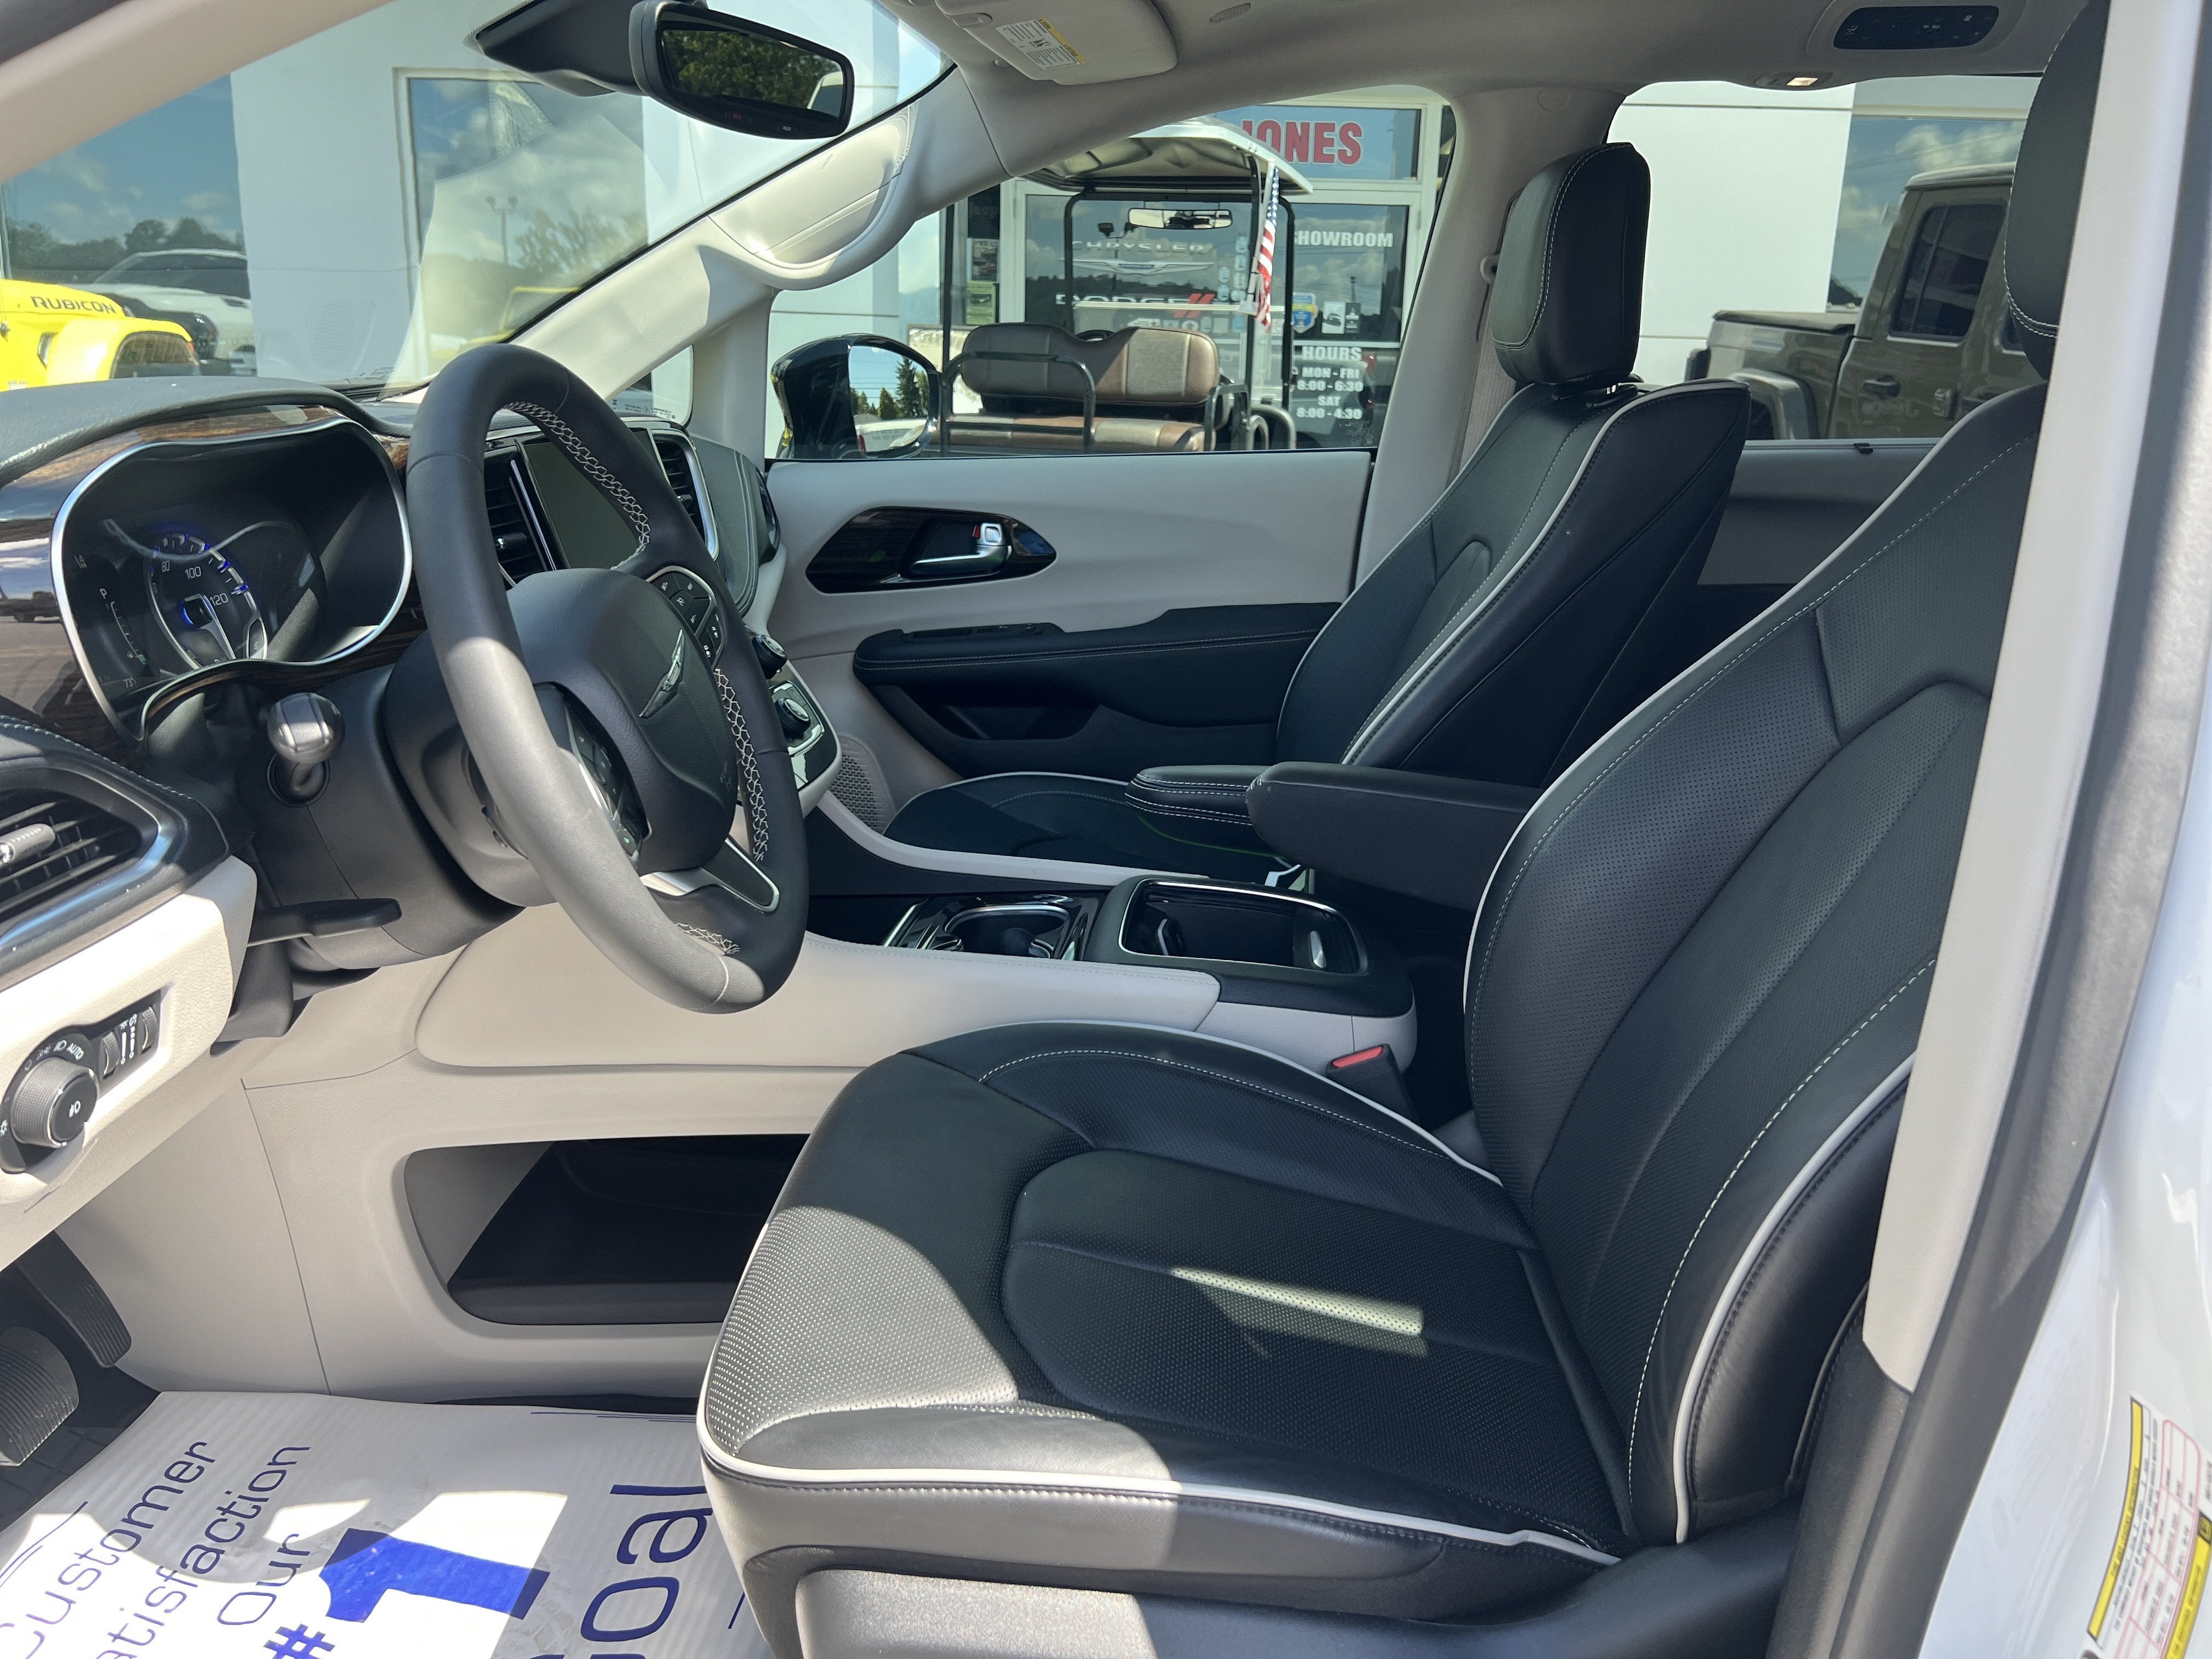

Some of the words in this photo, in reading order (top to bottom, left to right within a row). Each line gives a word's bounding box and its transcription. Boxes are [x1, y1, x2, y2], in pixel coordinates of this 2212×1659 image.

[1294, 231, 1393, 247] HOWROOM
[31, 295, 117, 314] RUBICON
[1302, 346, 1363, 361] HOURS
[1317, 395, 1341, 407] SAT
[161, 560, 171, 572] 80
[185, 566, 202, 579] 100
[99, 588, 108, 599] P
[210, 592, 229, 606] 120
[66, 1043, 85, 1061] AUTO
[217, 1533, 311, 1625] Our
[530, 1484, 713, 1659] oal
